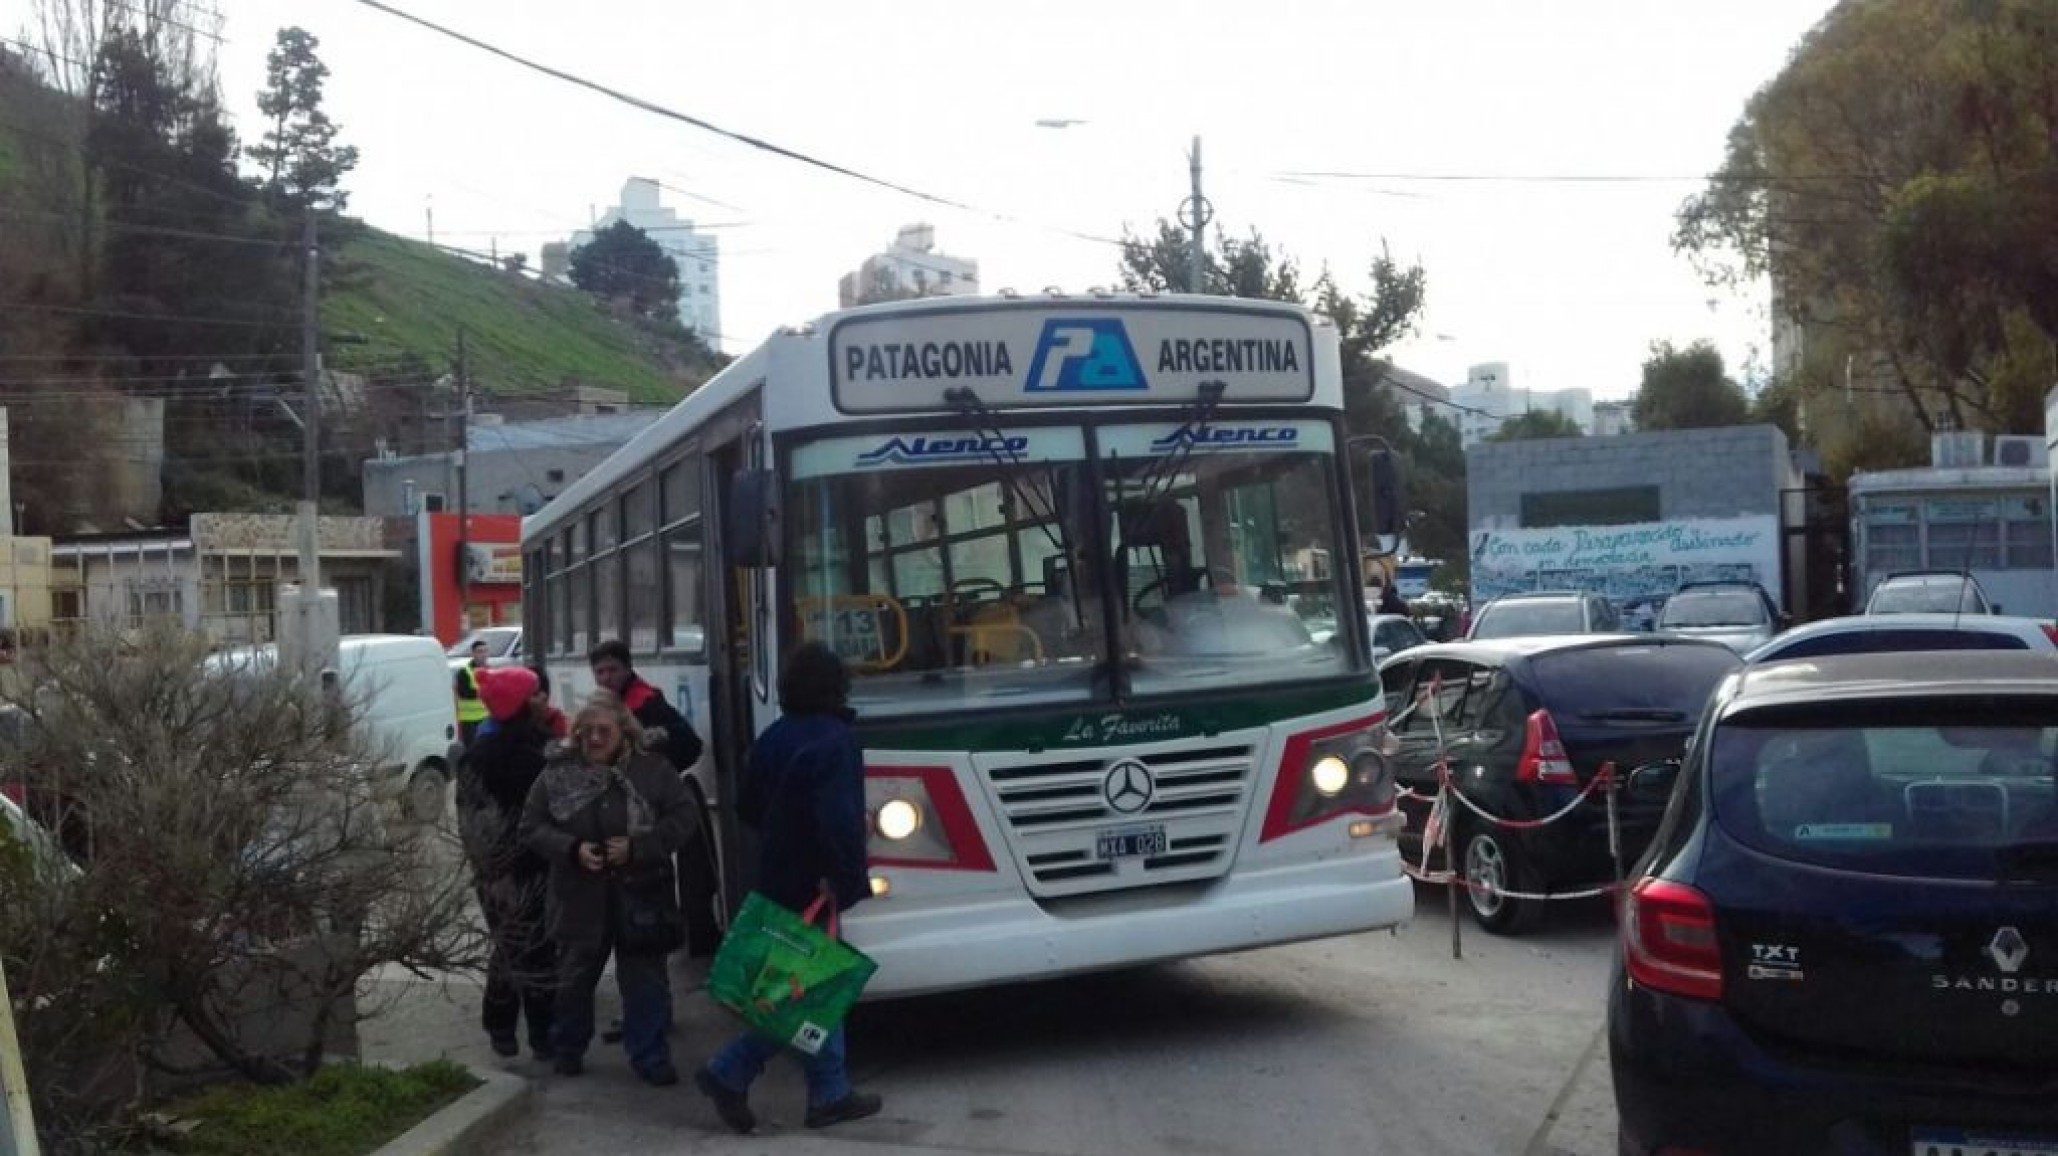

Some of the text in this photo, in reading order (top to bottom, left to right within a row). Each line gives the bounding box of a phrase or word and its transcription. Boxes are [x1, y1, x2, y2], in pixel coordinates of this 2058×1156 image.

[846, 341, 1013, 381] PATAGONIA
[1157, 338, 1298, 373] ARGENTINA
[1152, 423, 1298, 444] Alenco
[858, 436, 1028, 458] Alenco
[1063, 713, 1181, 741] La Favorita
[1752, 944, 1800, 961] TXT
